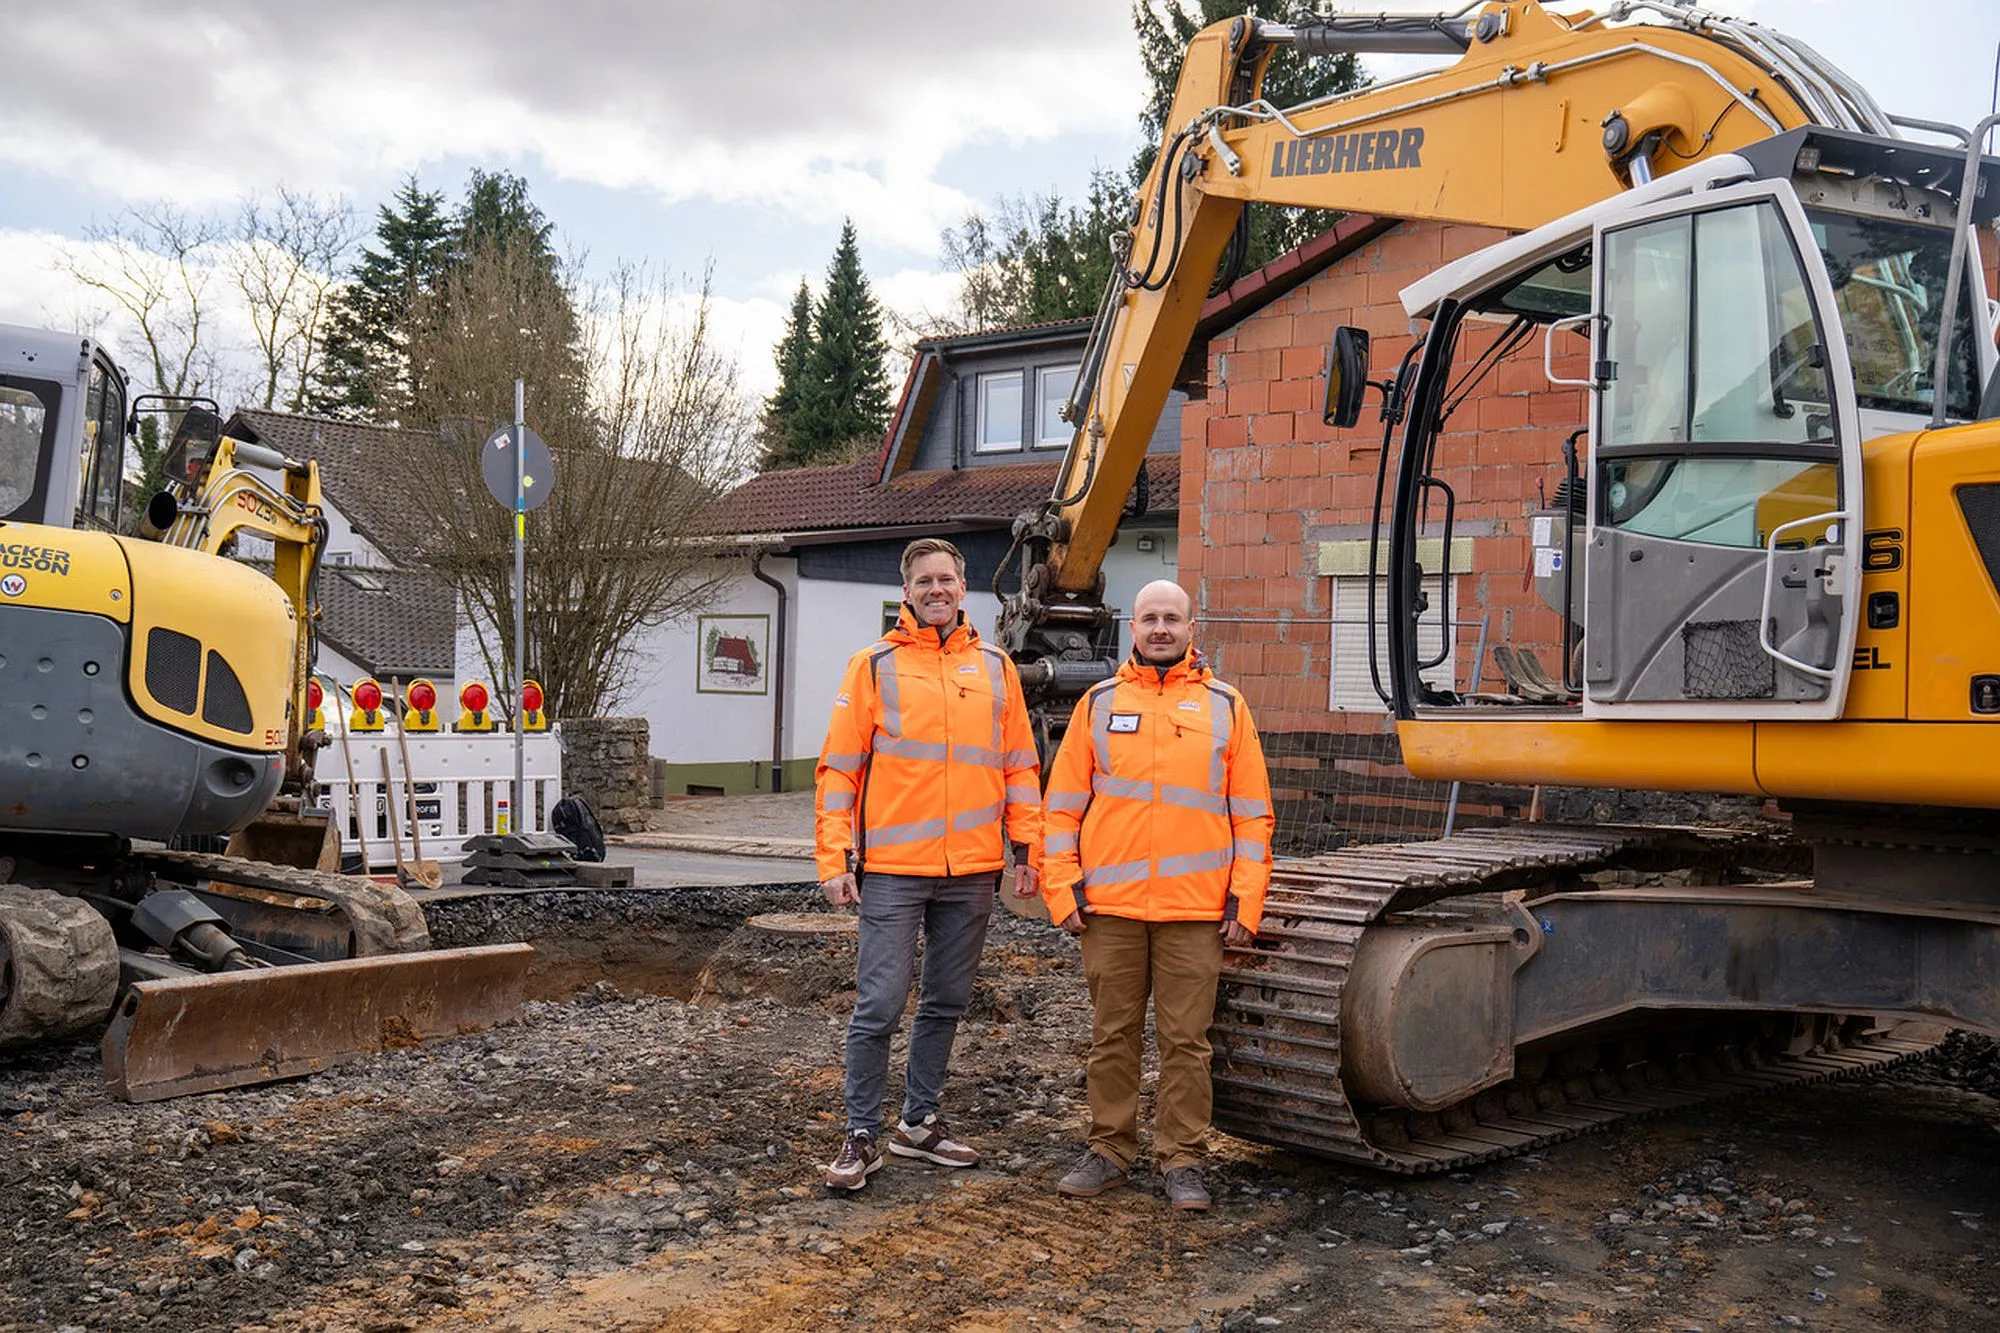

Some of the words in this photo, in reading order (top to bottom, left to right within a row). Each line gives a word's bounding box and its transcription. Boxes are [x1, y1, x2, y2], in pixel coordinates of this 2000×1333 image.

[1271, 127, 1425, 178] LIEBHERR
[0, 554, 70, 576] USON
[1852, 647, 1891, 669] EL
